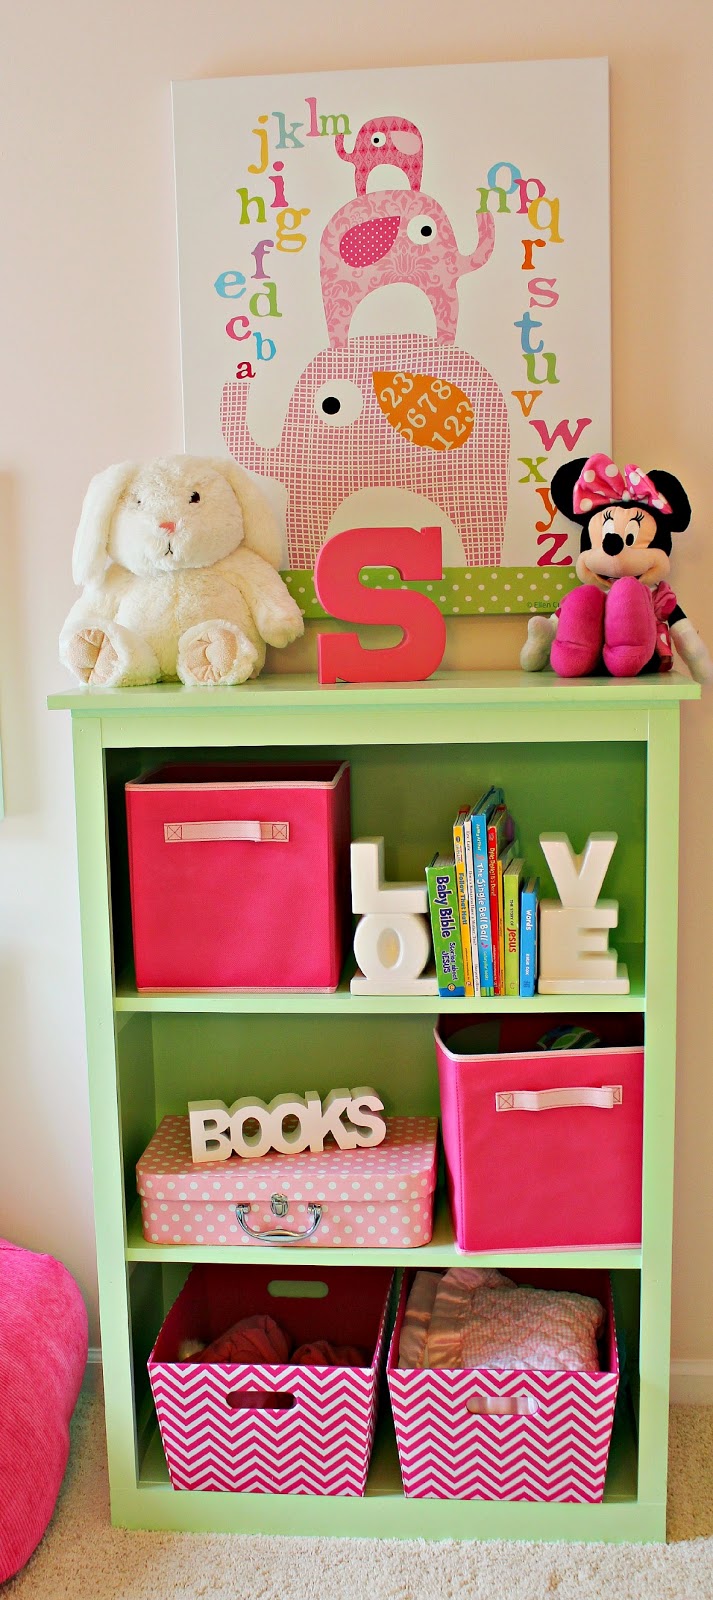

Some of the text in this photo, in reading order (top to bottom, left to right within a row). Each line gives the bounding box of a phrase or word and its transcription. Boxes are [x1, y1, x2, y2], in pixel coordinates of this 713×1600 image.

[272, 112, 304, 149] k
[305, 97, 320, 136] l
[319, 113, 352, 136] m
[247, 115, 268, 174] j
[268, 161, 289, 208] i
[487, 162, 521, 194] o
[236, 188, 267, 225] h
[476, 187, 511, 214] n
[514, 178, 546, 214] p
[276, 208, 311, 253] g
[528, 197, 564, 243] q
[251, 239, 274, 279] f
[521, 239, 546, 270] r
[214, 270, 246, 299] e
[249, 282, 282, 317] d
[528, 277, 559, 308] s
[226, 315, 251, 341] c
[513, 312, 544, 353] t
[253, 332, 276, 361] b
[236, 361, 256, 379] a
[522, 352, 560, 384] u
[511, 390, 543, 417] v
[529, 418, 592, 451] w
[517, 456, 548, 483] x
[535, 487, 558, 532] y
[537, 533, 573, 566] z
[314, 527, 447, 684] S
[458, 872, 466, 893] Follow
[434, 875, 456, 939] Baby Bible
[476, 863, 489, 942] The Jingle Bell Ball
[507, 927, 517, 953] Jesus
[441, 951, 451, 974] JESUS
[451, 964, 459, 981] about
[187, 1086, 387, 1164] BOOKS
